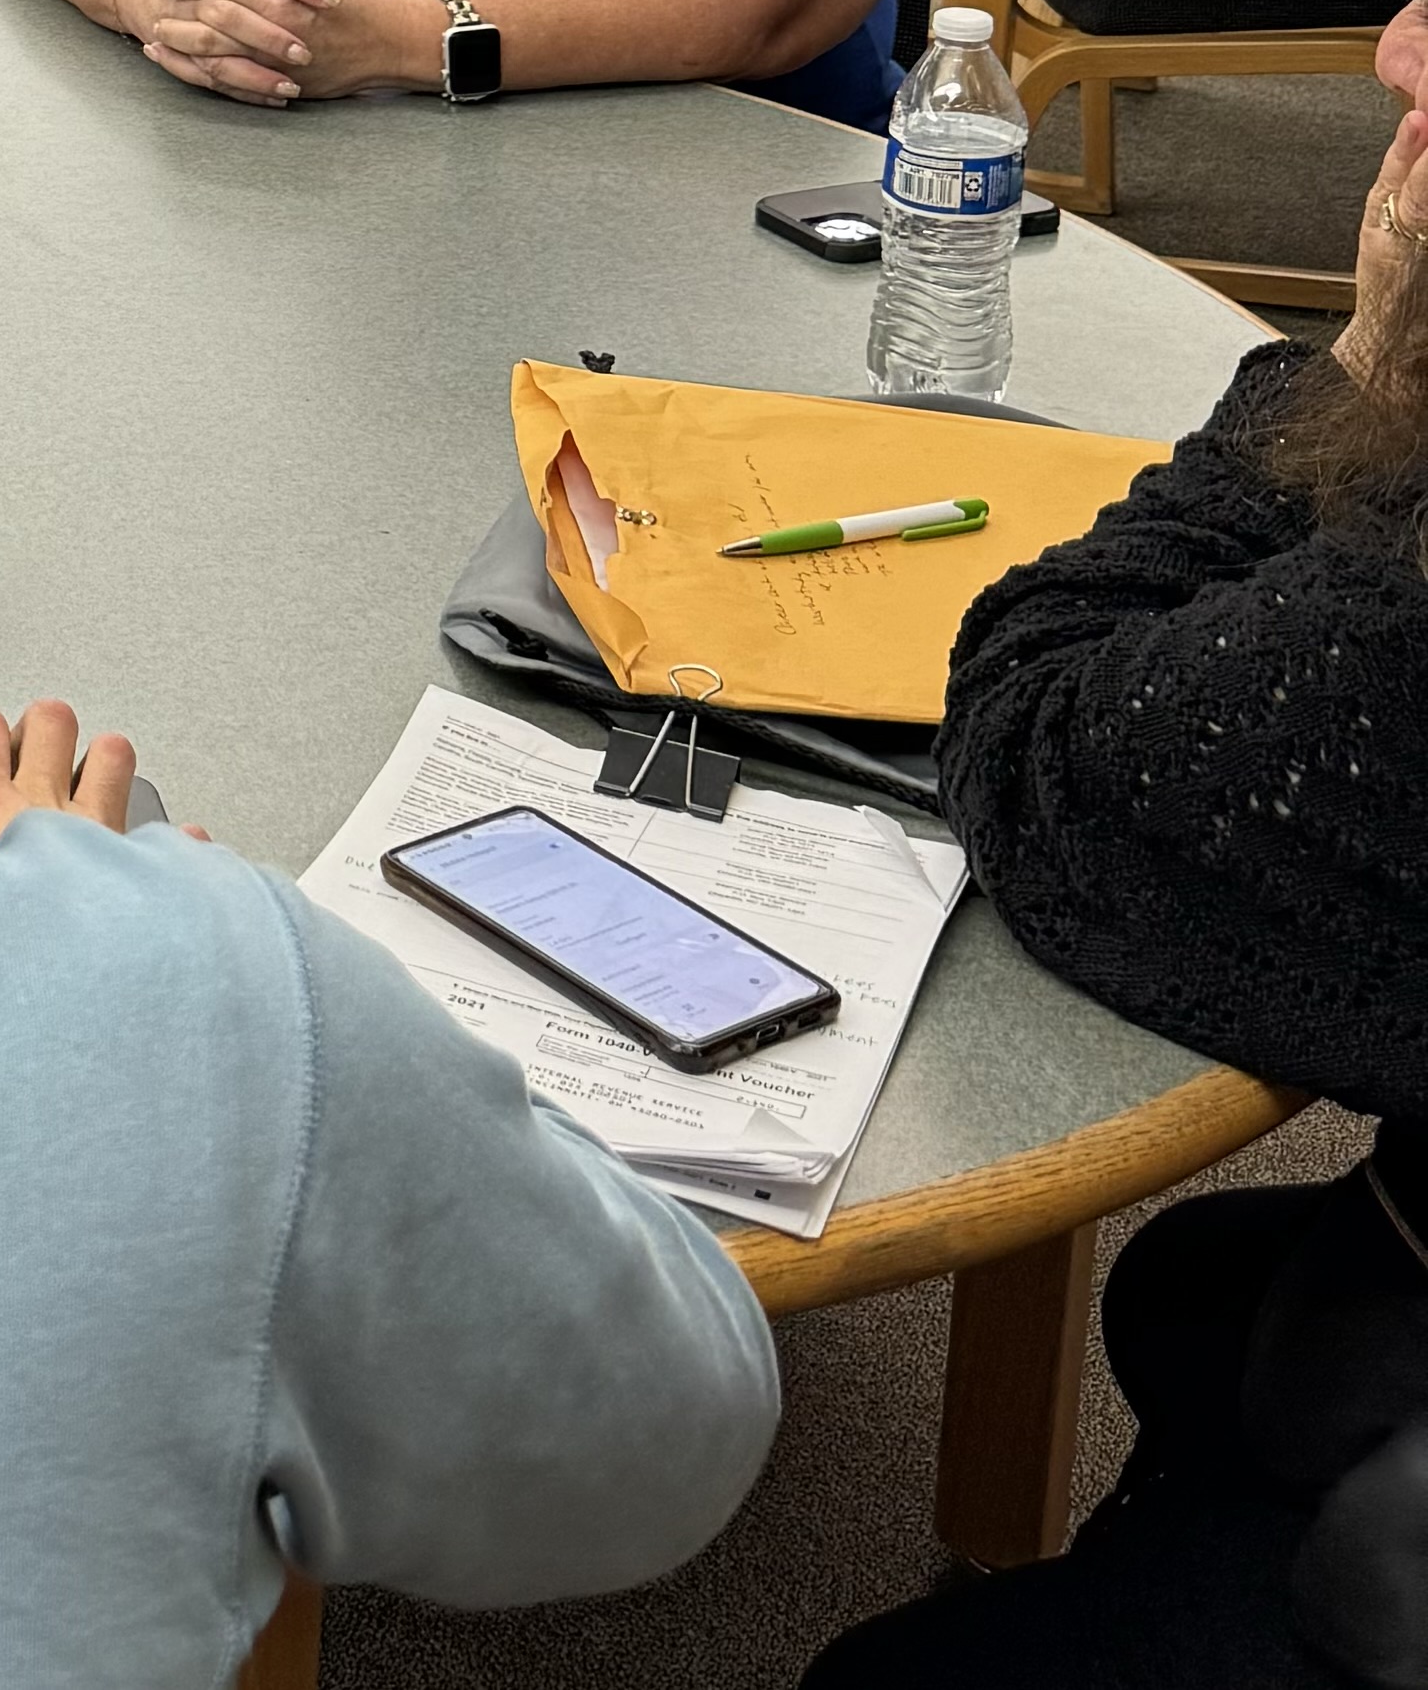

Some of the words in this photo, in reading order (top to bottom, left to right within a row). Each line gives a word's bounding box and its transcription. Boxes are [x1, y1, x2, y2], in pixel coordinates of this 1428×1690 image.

[447, 993, 486, 1011] 2021
[545, 1021, 591, 1041] Form
[740, 1073, 816, 1099] Voucher
